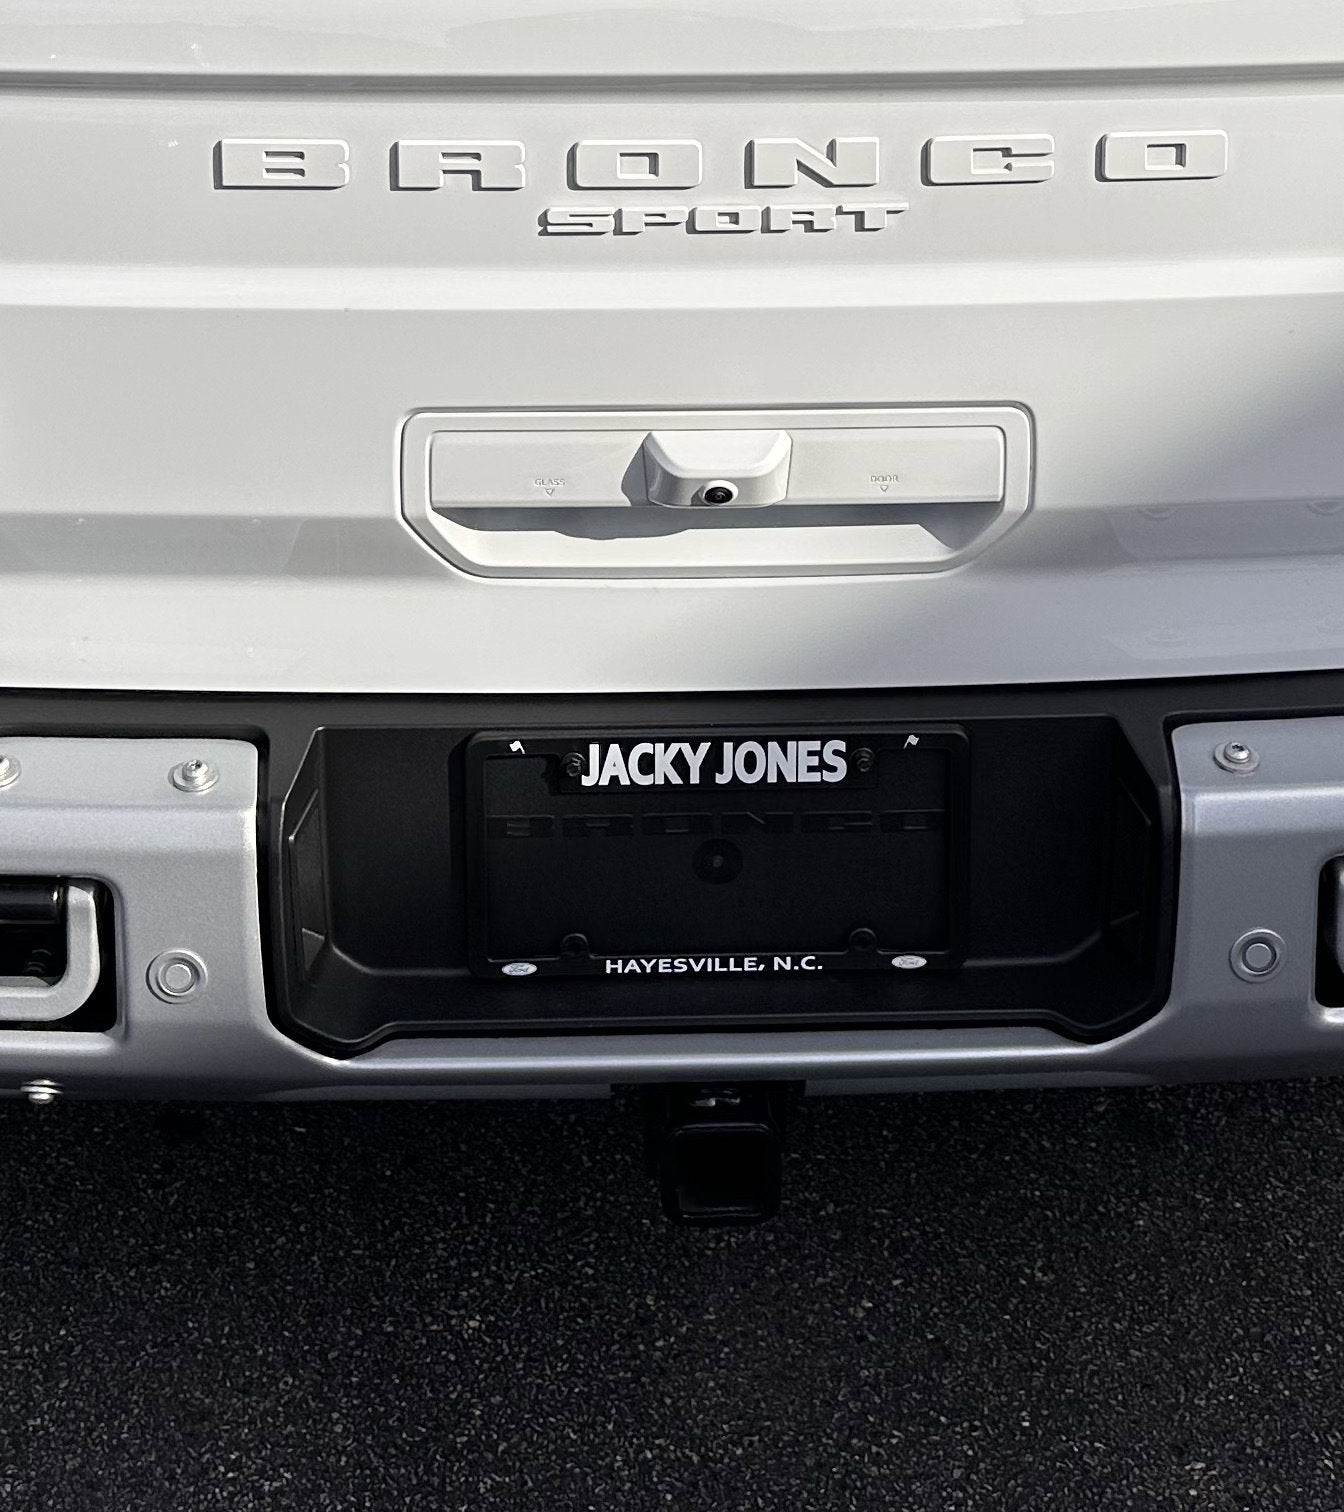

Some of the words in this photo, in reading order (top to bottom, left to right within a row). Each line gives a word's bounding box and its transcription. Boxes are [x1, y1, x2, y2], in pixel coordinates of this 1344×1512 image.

[212, 128, 1229, 191] BRONCO
[537, 201, 910, 237] SPORT
[534, 478, 567, 487] GLASS
[580, 741, 712, 787] JACKY
[714, 739, 848, 785] JONES
[604, 956, 766, 975] HAYESVILLE,
[772, 955, 824, 971] N.C.
